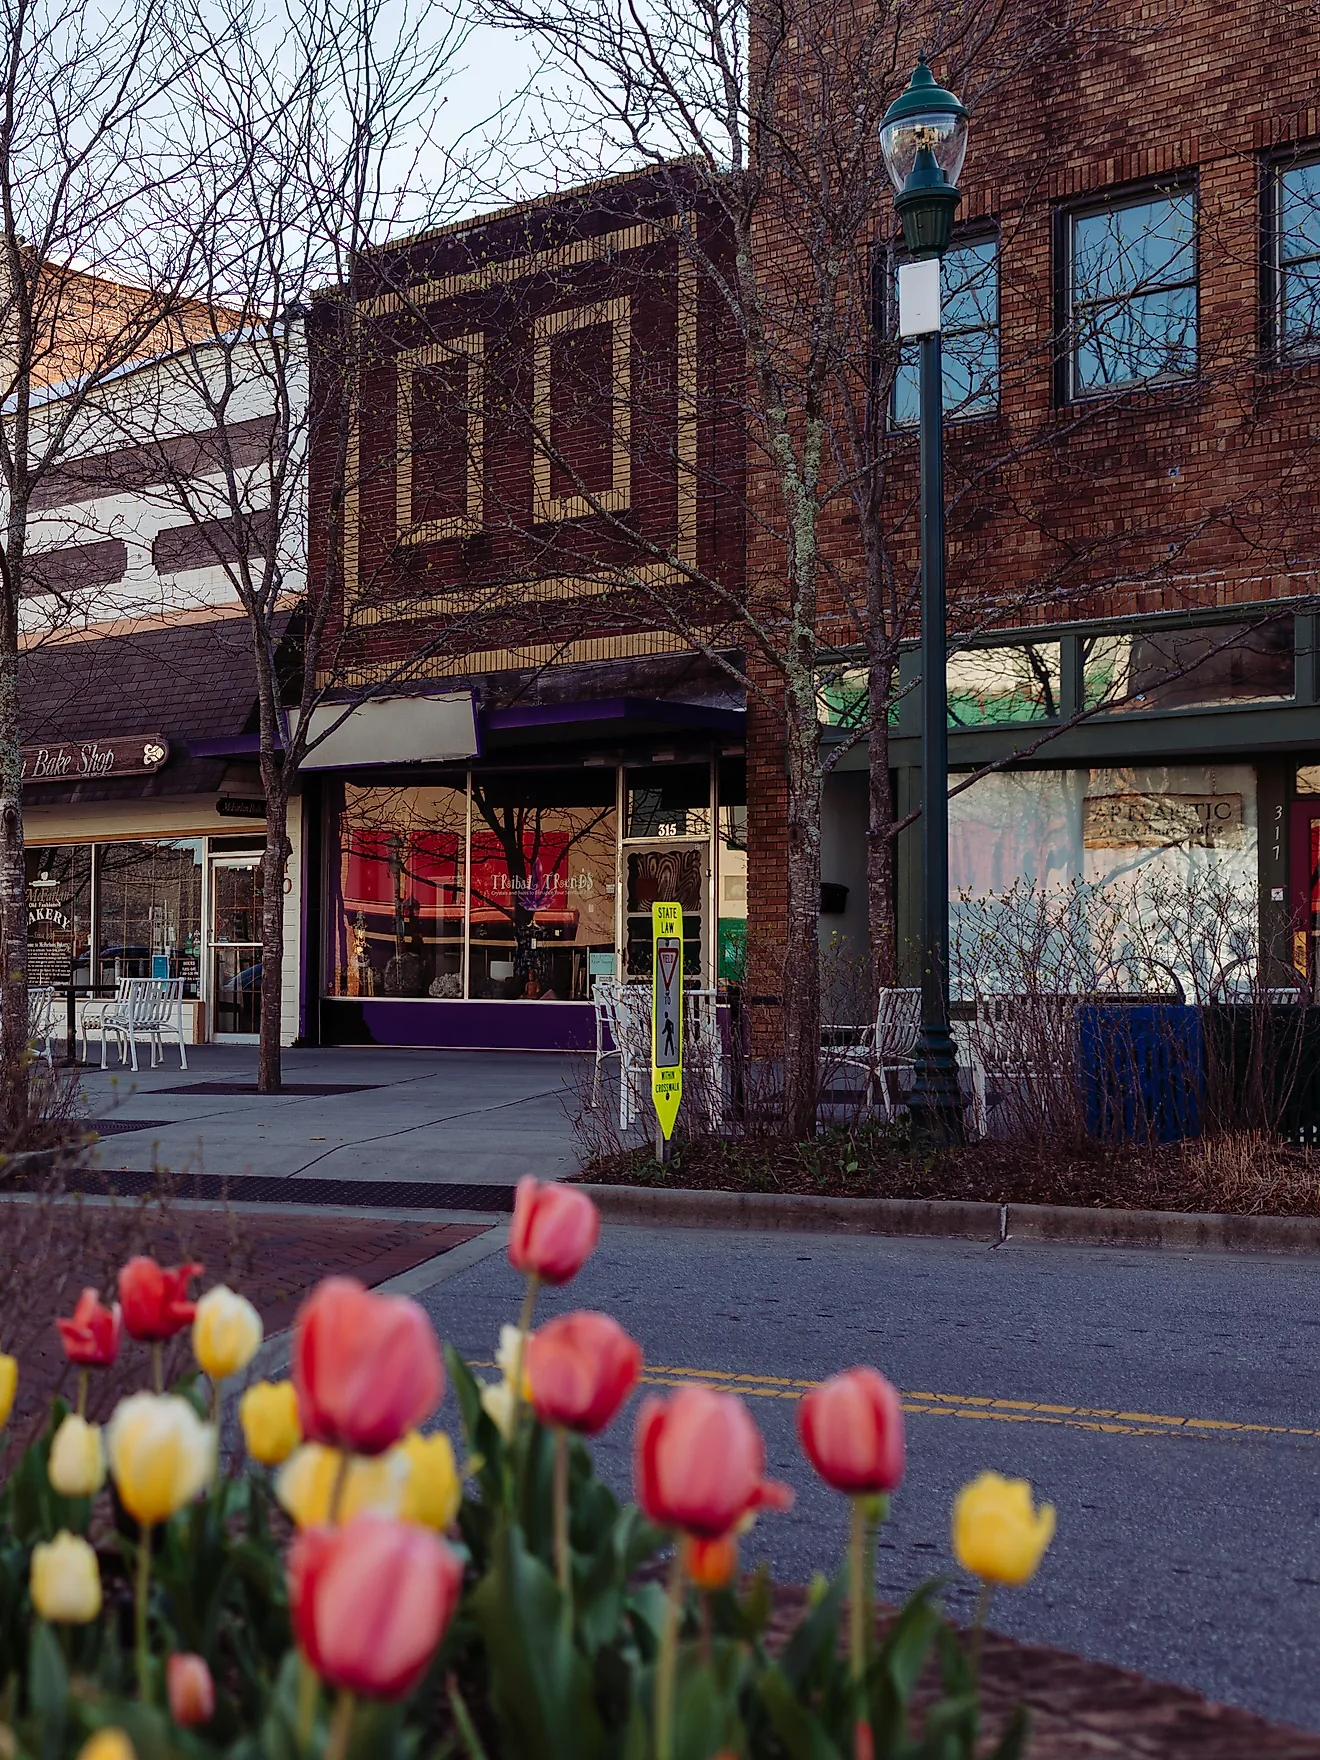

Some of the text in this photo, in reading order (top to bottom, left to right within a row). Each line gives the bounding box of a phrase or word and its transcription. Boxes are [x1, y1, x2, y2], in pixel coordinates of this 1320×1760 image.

[31, 749, 72, 778] Bake
[76, 744, 115, 777] Shop
[658, 824, 677, 836] 315
[26, 908, 70, 930] AKERY
[658, 907, 678, 919] STATE
[661, 922, 675, 934] LAW
[662, 954, 674, 964] YIELD
[664, 995, 671, 1006] TO
[661, 1072, 675, 1080] WITHIN
[656, 1081, 680, 1093] CROSSWALK
